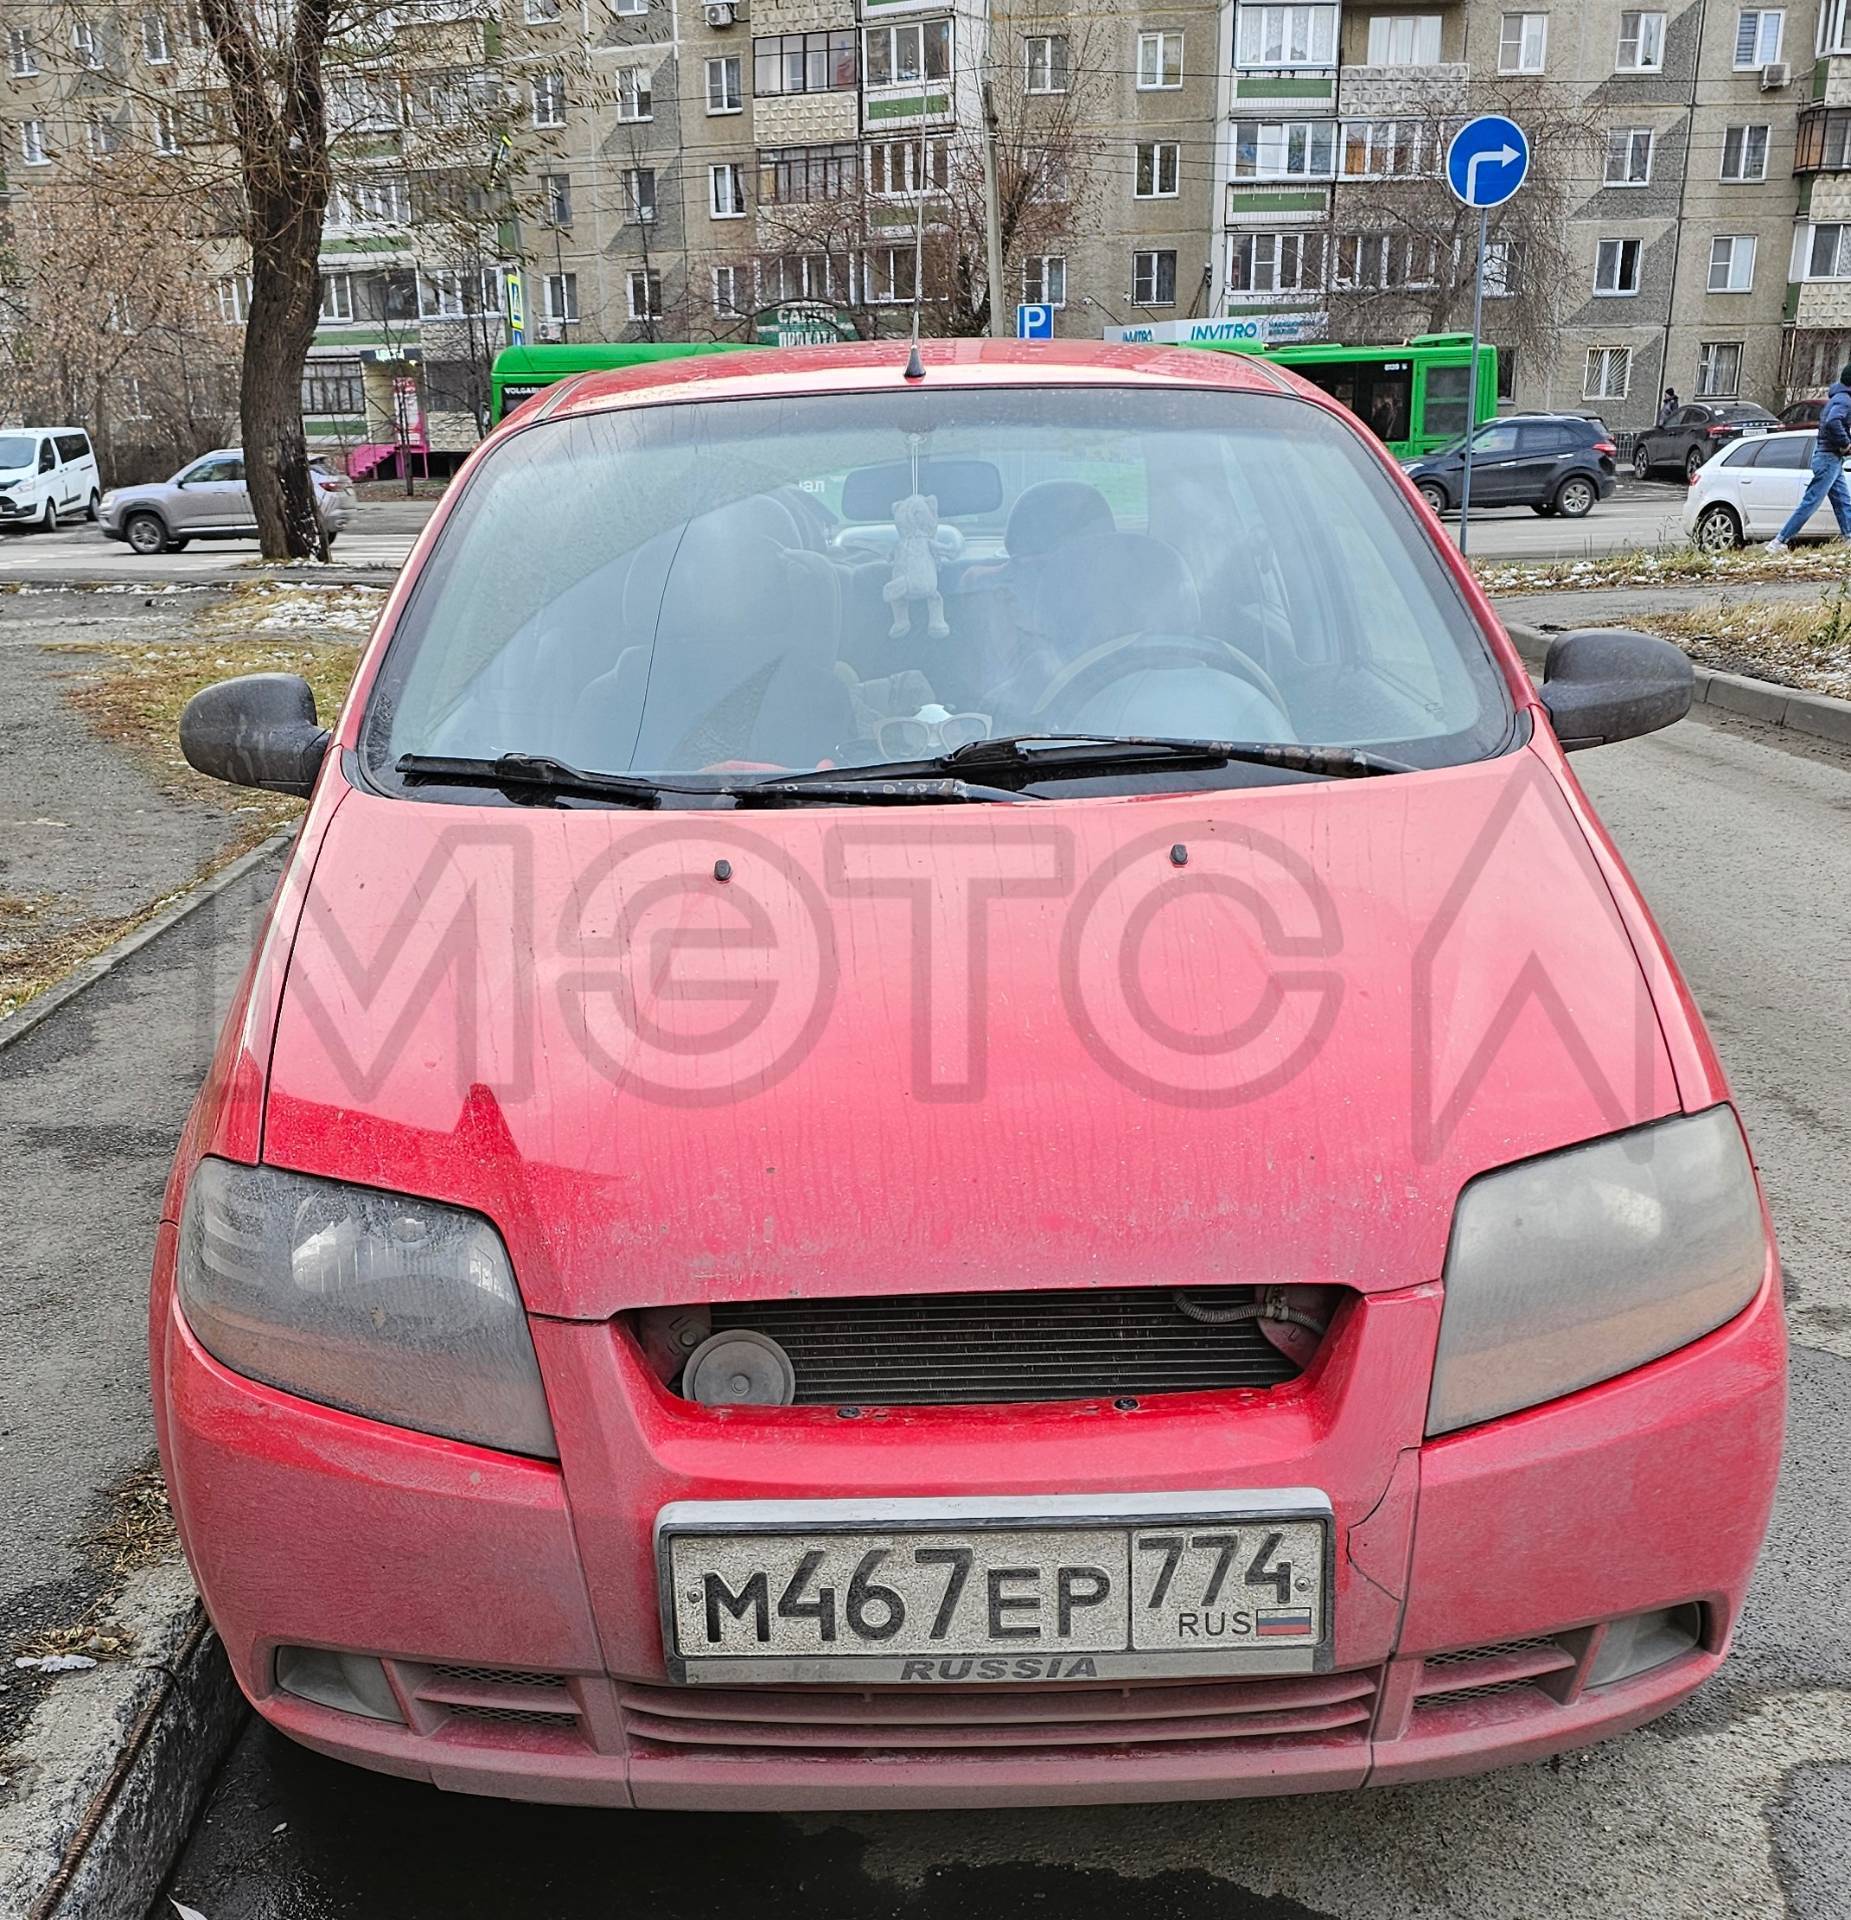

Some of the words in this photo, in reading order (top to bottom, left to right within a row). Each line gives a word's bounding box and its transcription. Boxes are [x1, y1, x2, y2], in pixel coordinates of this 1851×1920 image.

[1024, 306, 1046, 339] P
[1191, 322, 1257, 340] INVITRO
[1138, 1532, 1292, 1608] 774
[1178, 1611, 1253, 1637] RUS
[900, 1657, 1098, 1681] RUSSIA
